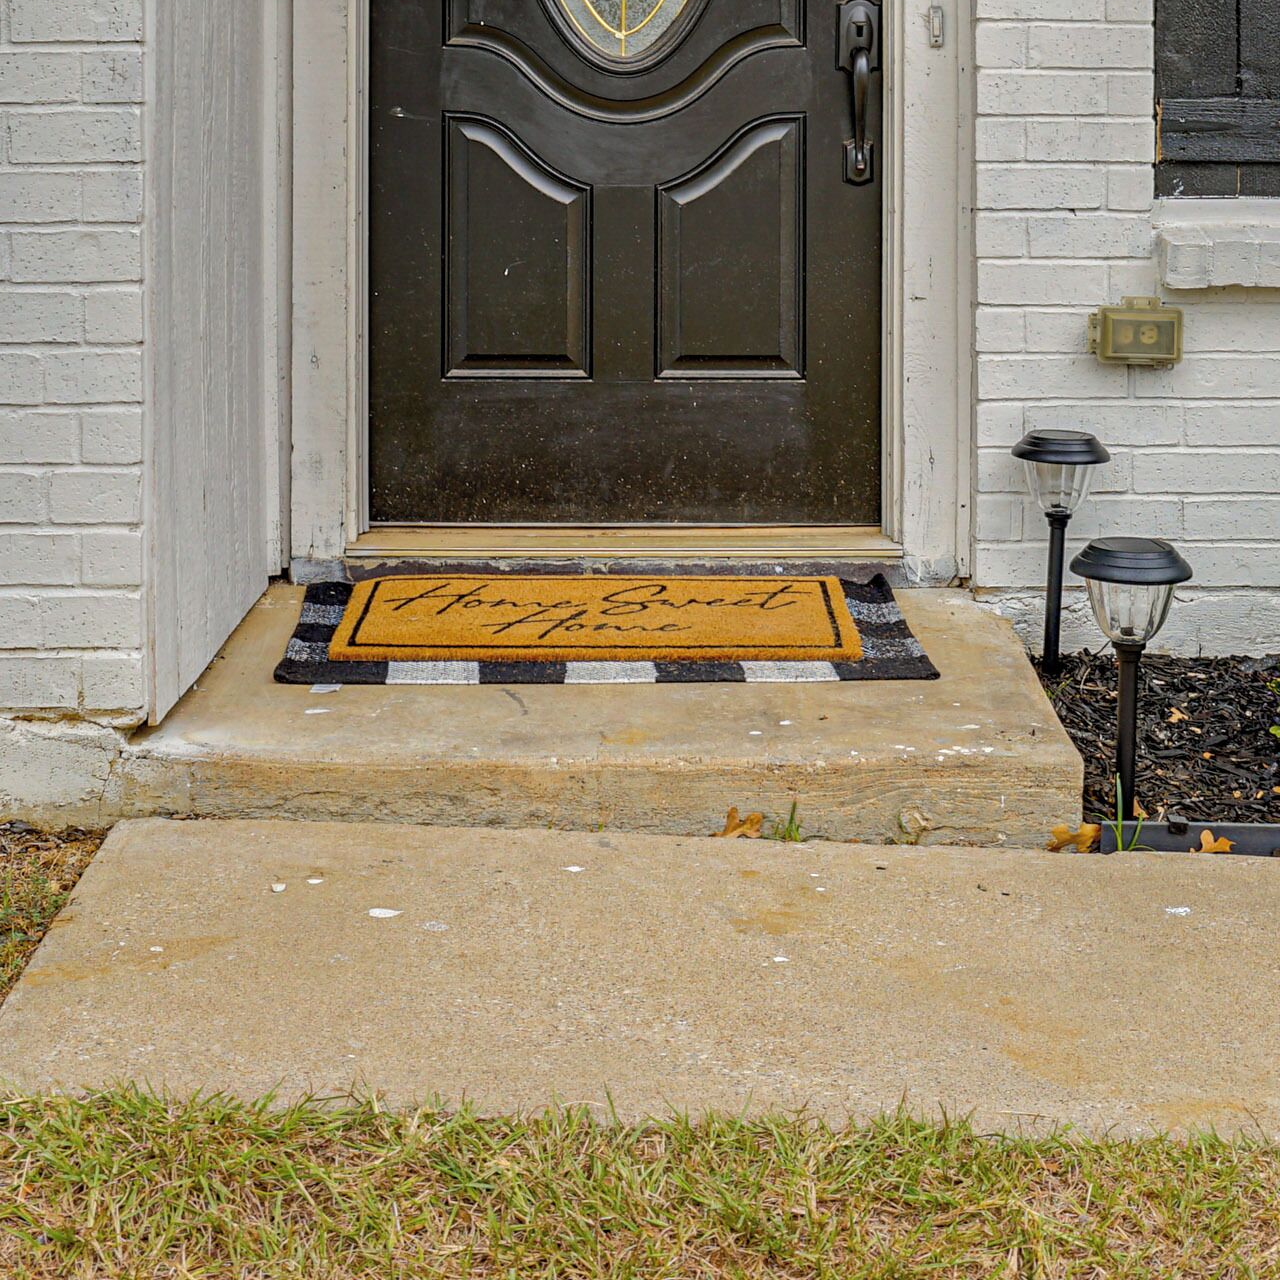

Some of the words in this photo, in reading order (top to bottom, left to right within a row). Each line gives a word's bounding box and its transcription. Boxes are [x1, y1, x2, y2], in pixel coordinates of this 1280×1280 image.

[383, 582, 588, 615] Home
[599, 584, 813, 616] Sweet
[480, 608, 692, 640] Home
